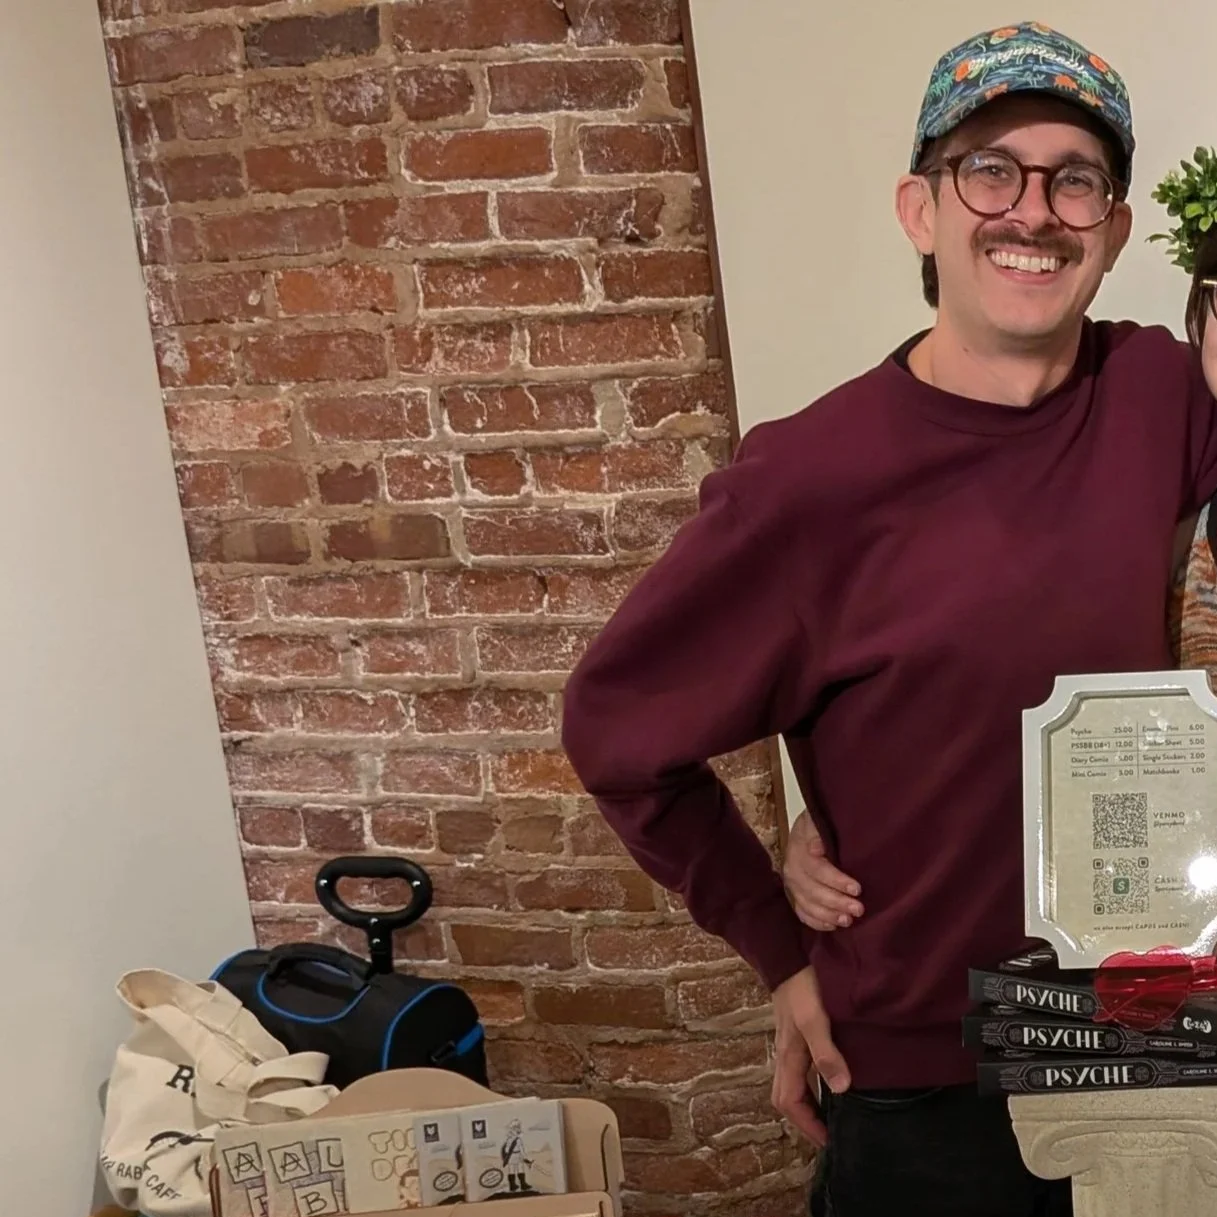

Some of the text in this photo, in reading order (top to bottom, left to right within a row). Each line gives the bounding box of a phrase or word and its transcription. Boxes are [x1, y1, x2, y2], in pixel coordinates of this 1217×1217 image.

[1071, 727, 1092, 736] Psyche
[1153, 811, 1186, 819] VENMO
[1016, 984, 1083, 1014] PSYCHE
[1023, 1027, 1105, 1050] PSYCHE
[1046, 1065, 1134, 1087] PSYCHE
